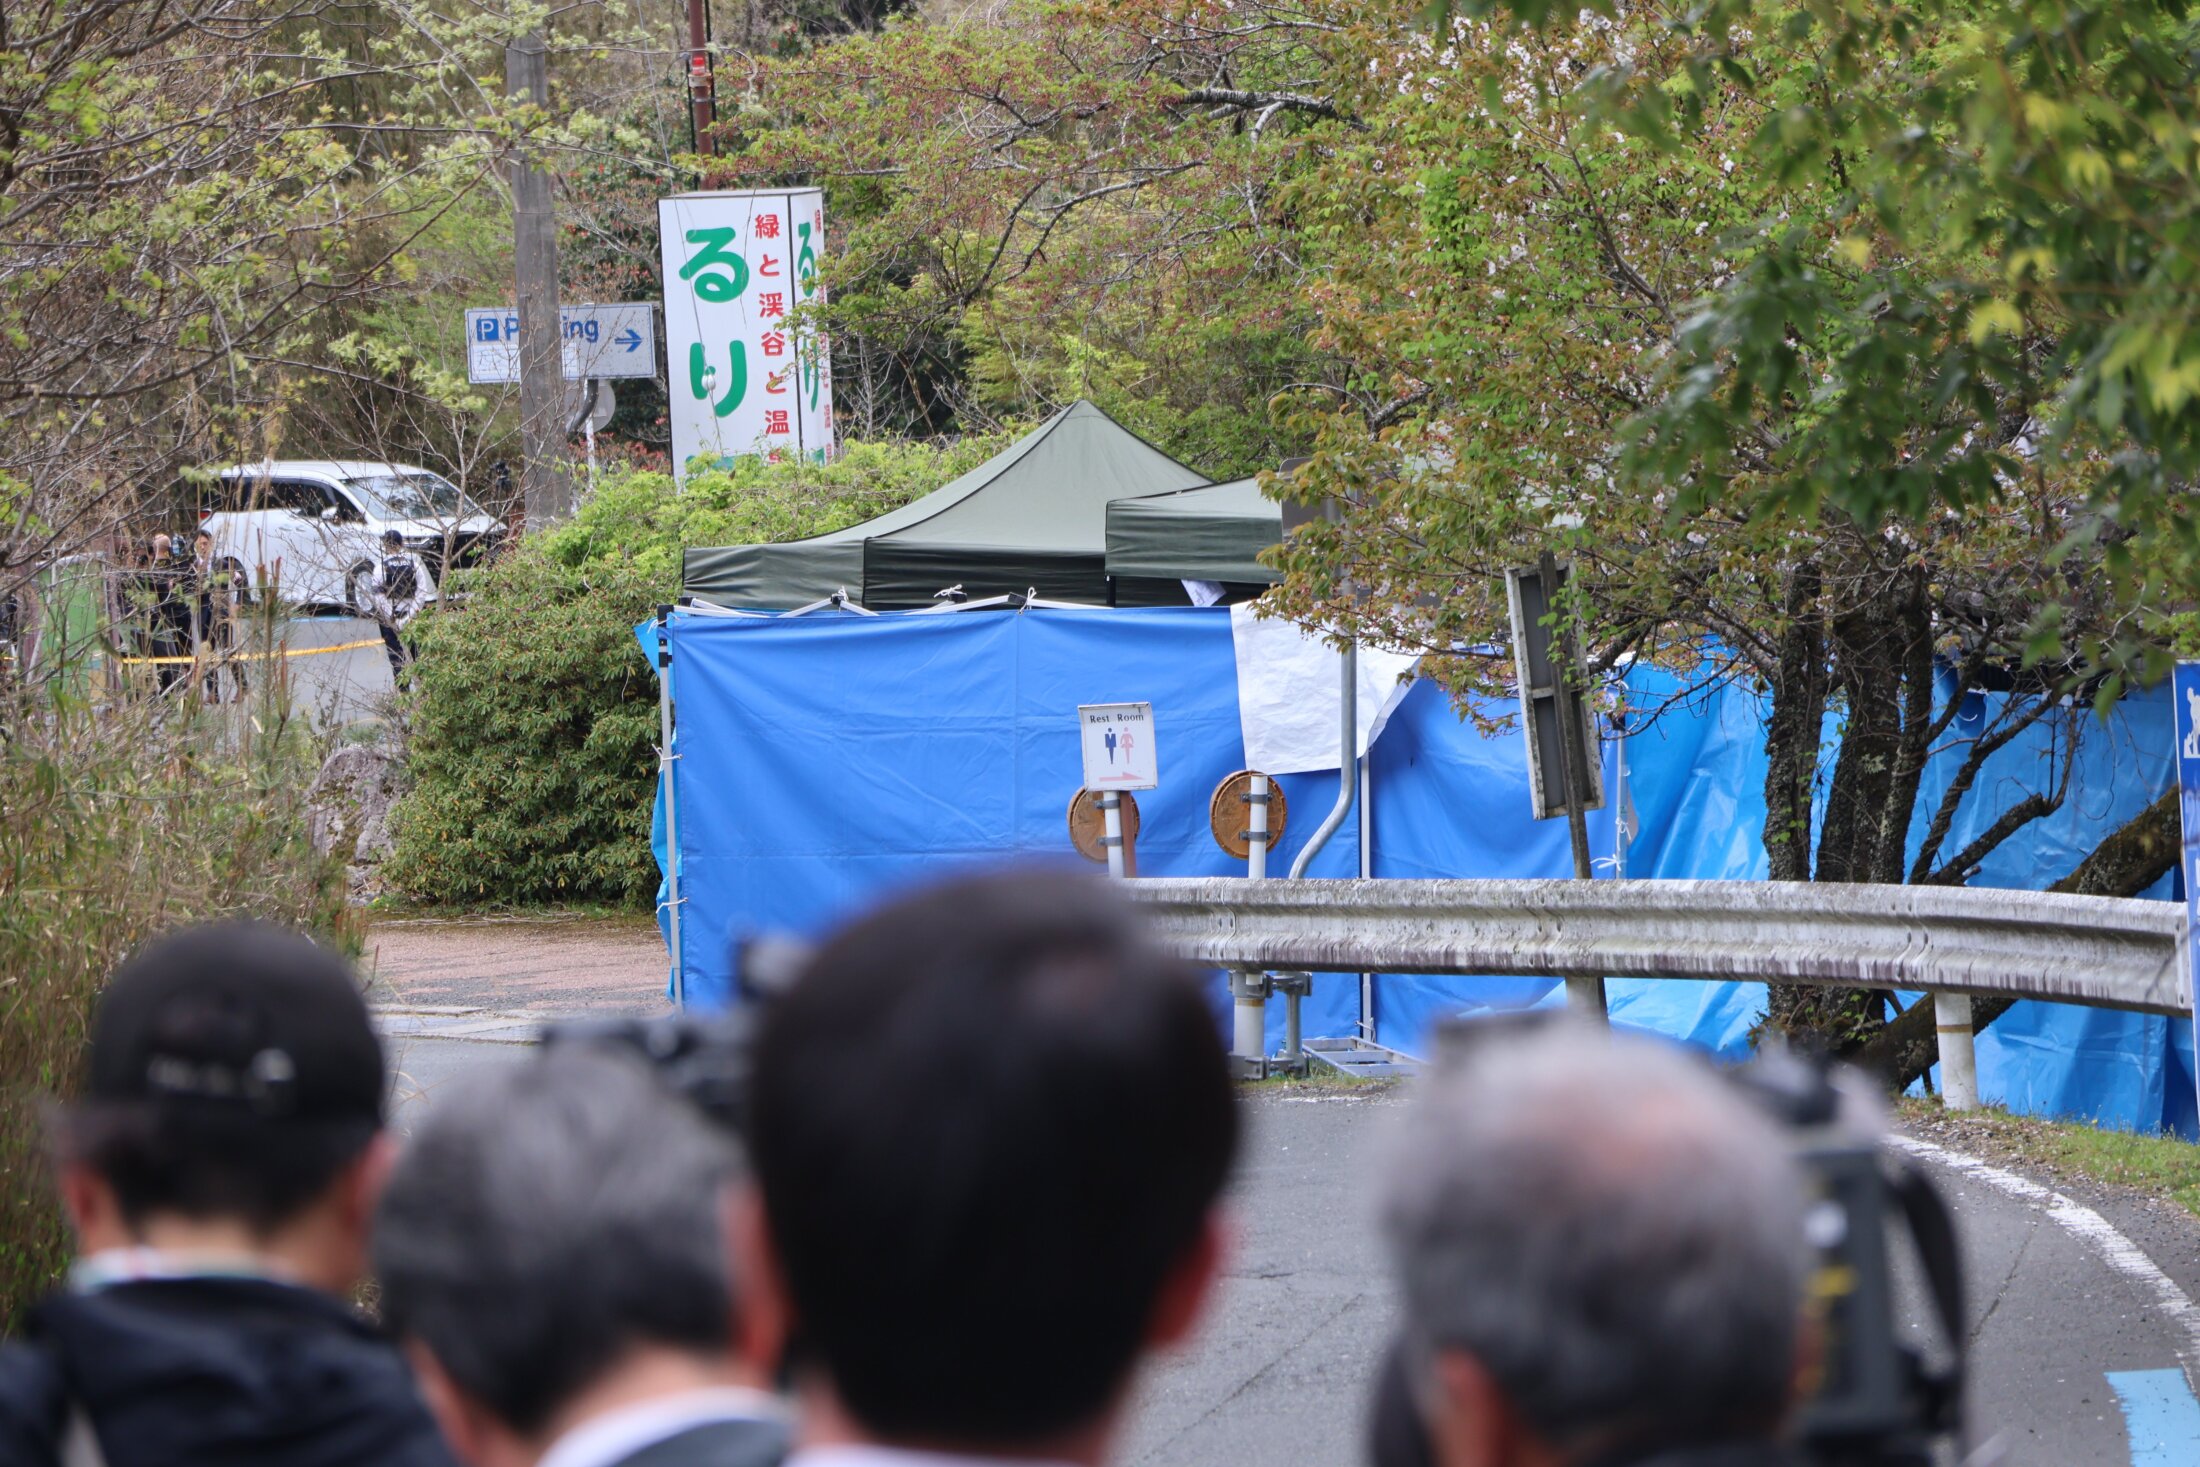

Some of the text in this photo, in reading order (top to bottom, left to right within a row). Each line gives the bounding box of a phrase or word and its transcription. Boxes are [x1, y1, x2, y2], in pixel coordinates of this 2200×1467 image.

[505, 317, 599, 343] Ping
[679, 226, 760, 470] るり
[1090, 712, 1144, 724] Rest Room
